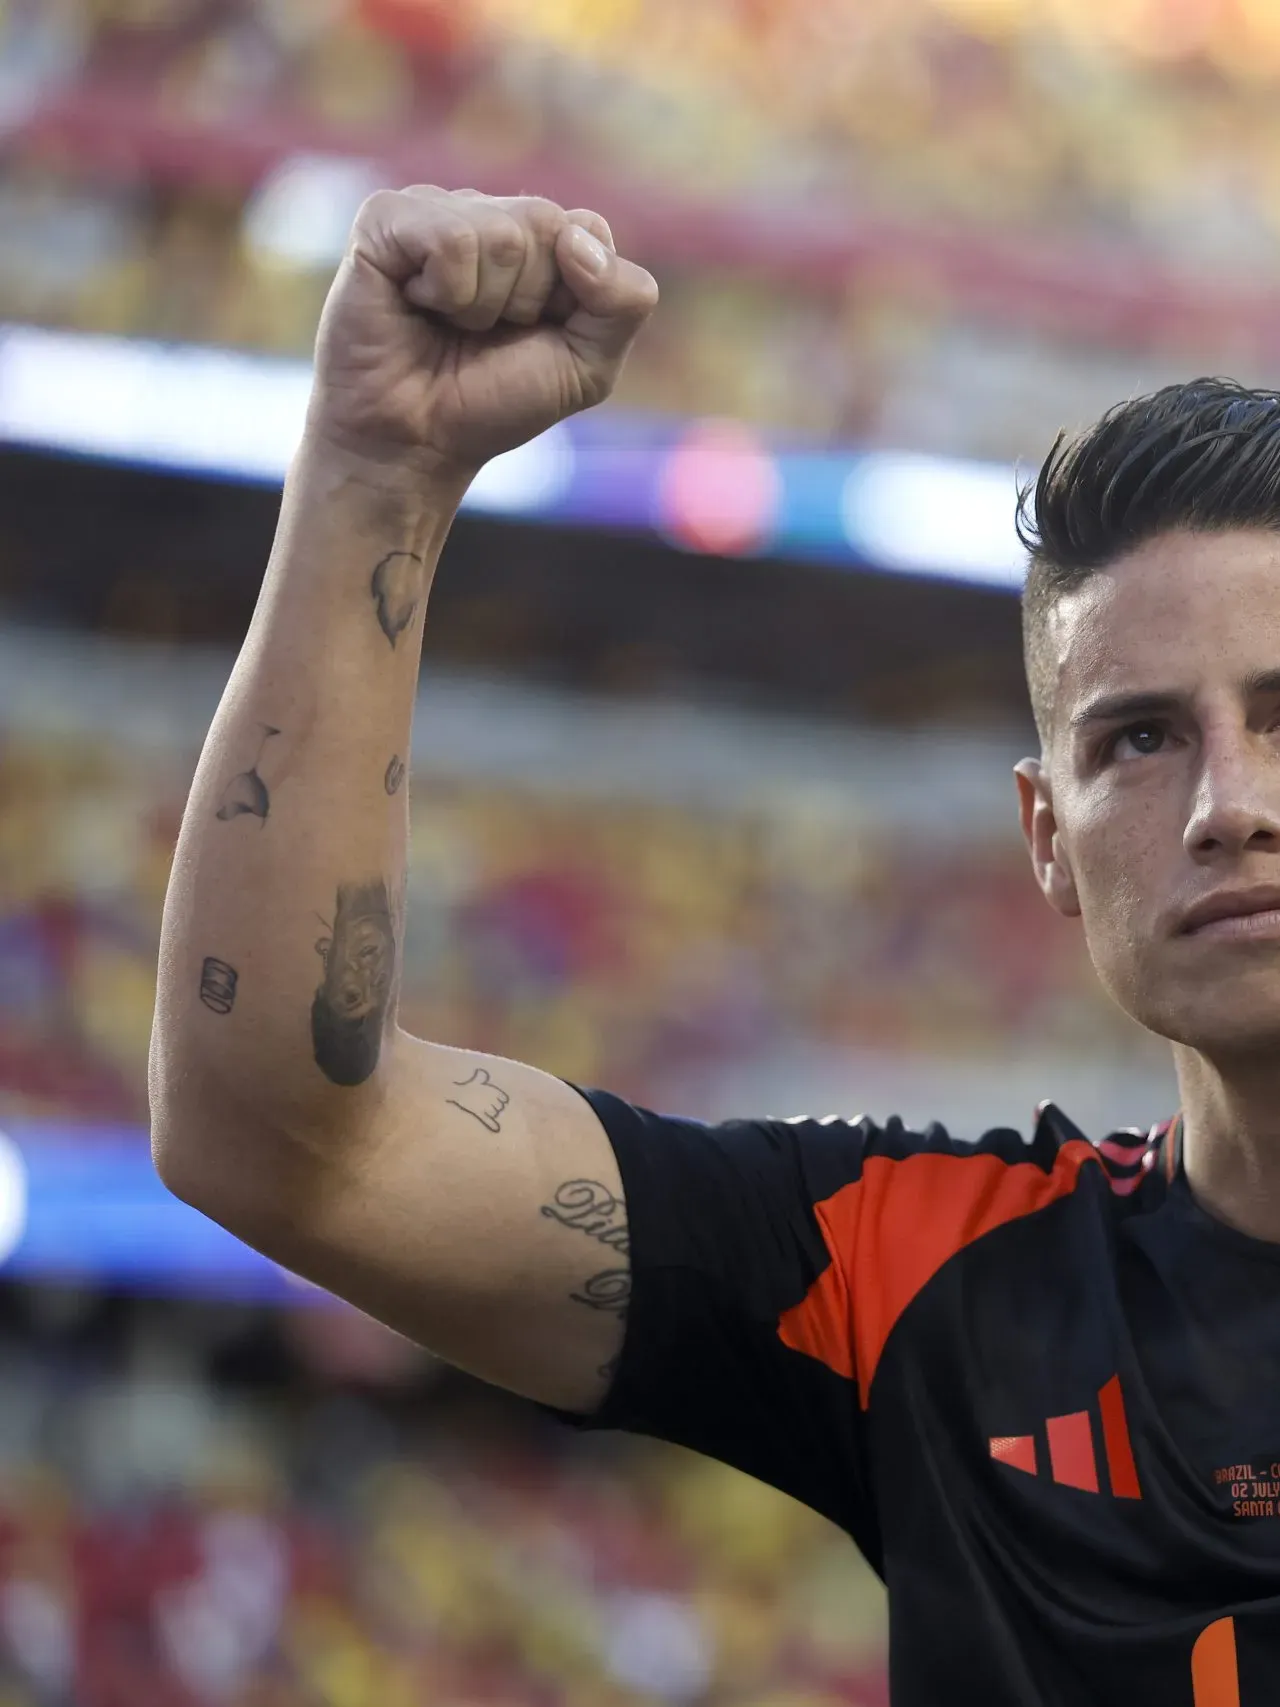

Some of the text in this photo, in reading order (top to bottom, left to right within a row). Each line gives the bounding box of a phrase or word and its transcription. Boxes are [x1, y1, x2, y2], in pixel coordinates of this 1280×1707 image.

[1215, 1464, 1256, 1484] BRAZIL
[1231, 1483, 1248, 1498] 02
[1252, 1481, 1280, 1498] JULY
[1233, 1500, 1273, 1517] SANTA
